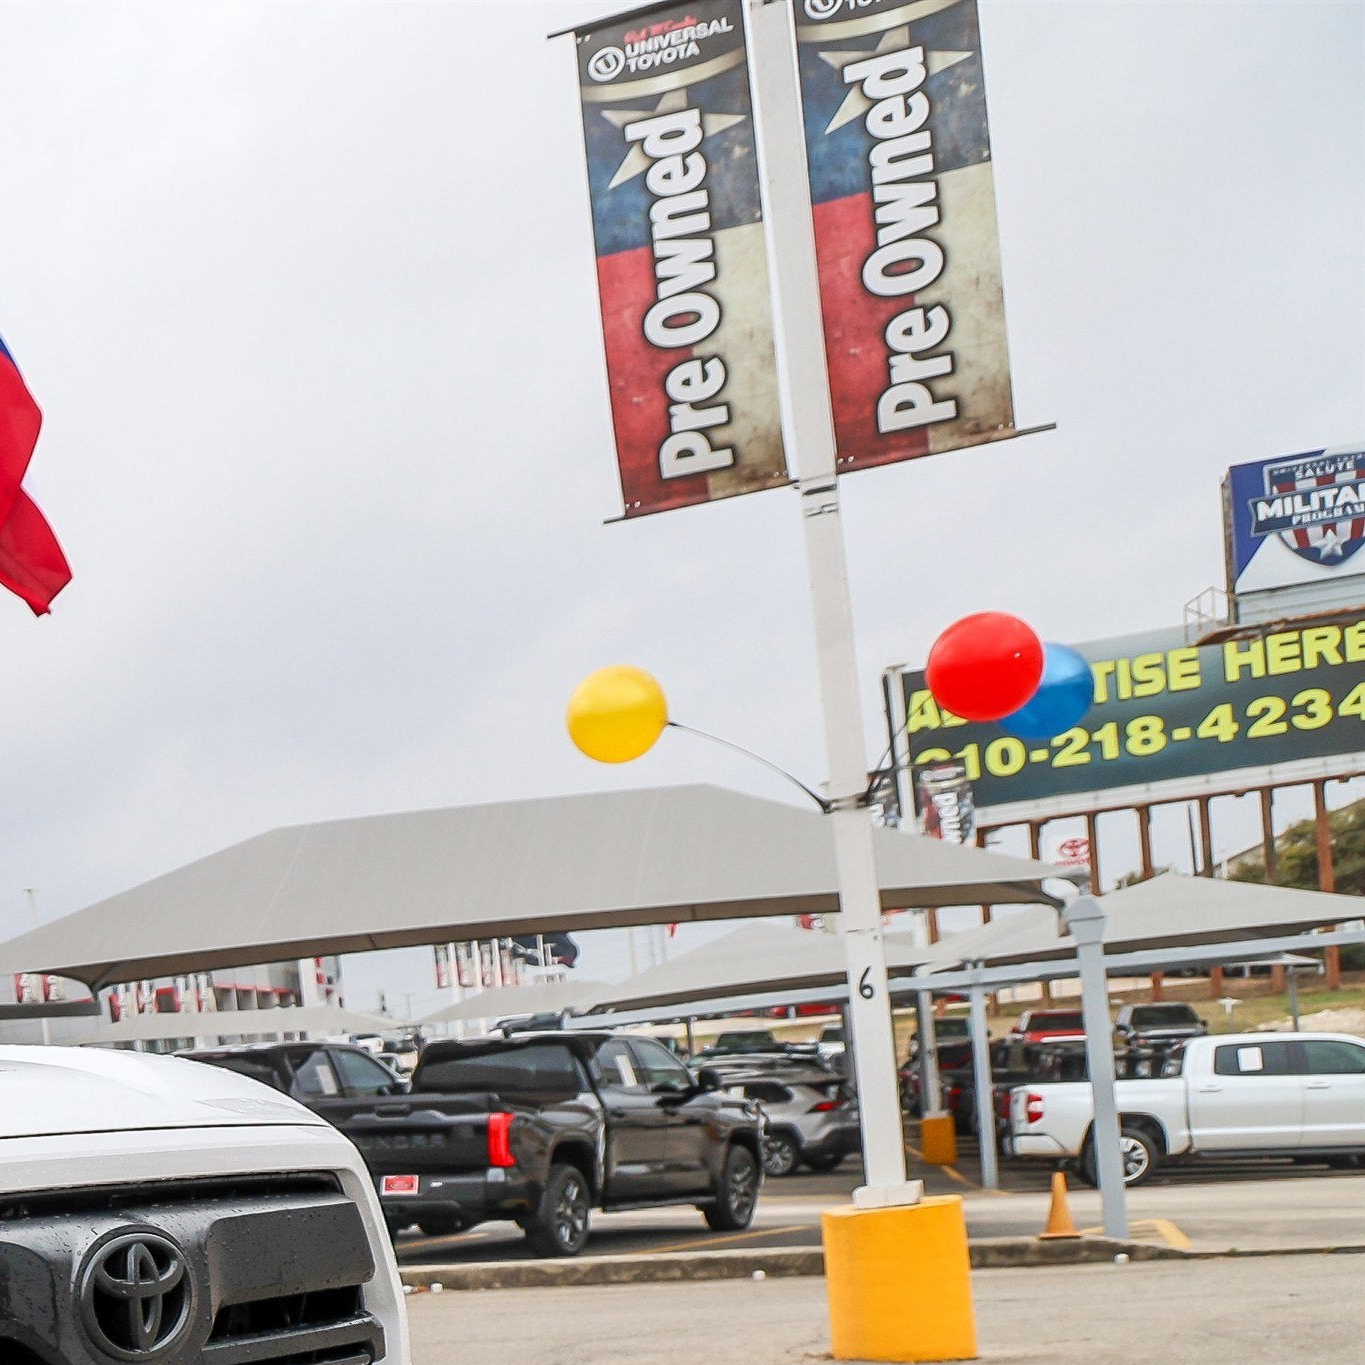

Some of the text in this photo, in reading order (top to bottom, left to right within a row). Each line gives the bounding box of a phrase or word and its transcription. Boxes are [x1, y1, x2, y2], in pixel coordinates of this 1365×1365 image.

[625, 17, 735, 58] UNIVERSAL
[626, 41, 701, 73] TOYOTA
[625, 107, 721, 349] Owned
[842, 45, 945, 297] Owned
[659, 356, 735, 479] Pre
[876, 303, 958, 434] Pre
[907, 620, 1365, 733] ATISE HERE
[859, 965, 874, 999] 6
